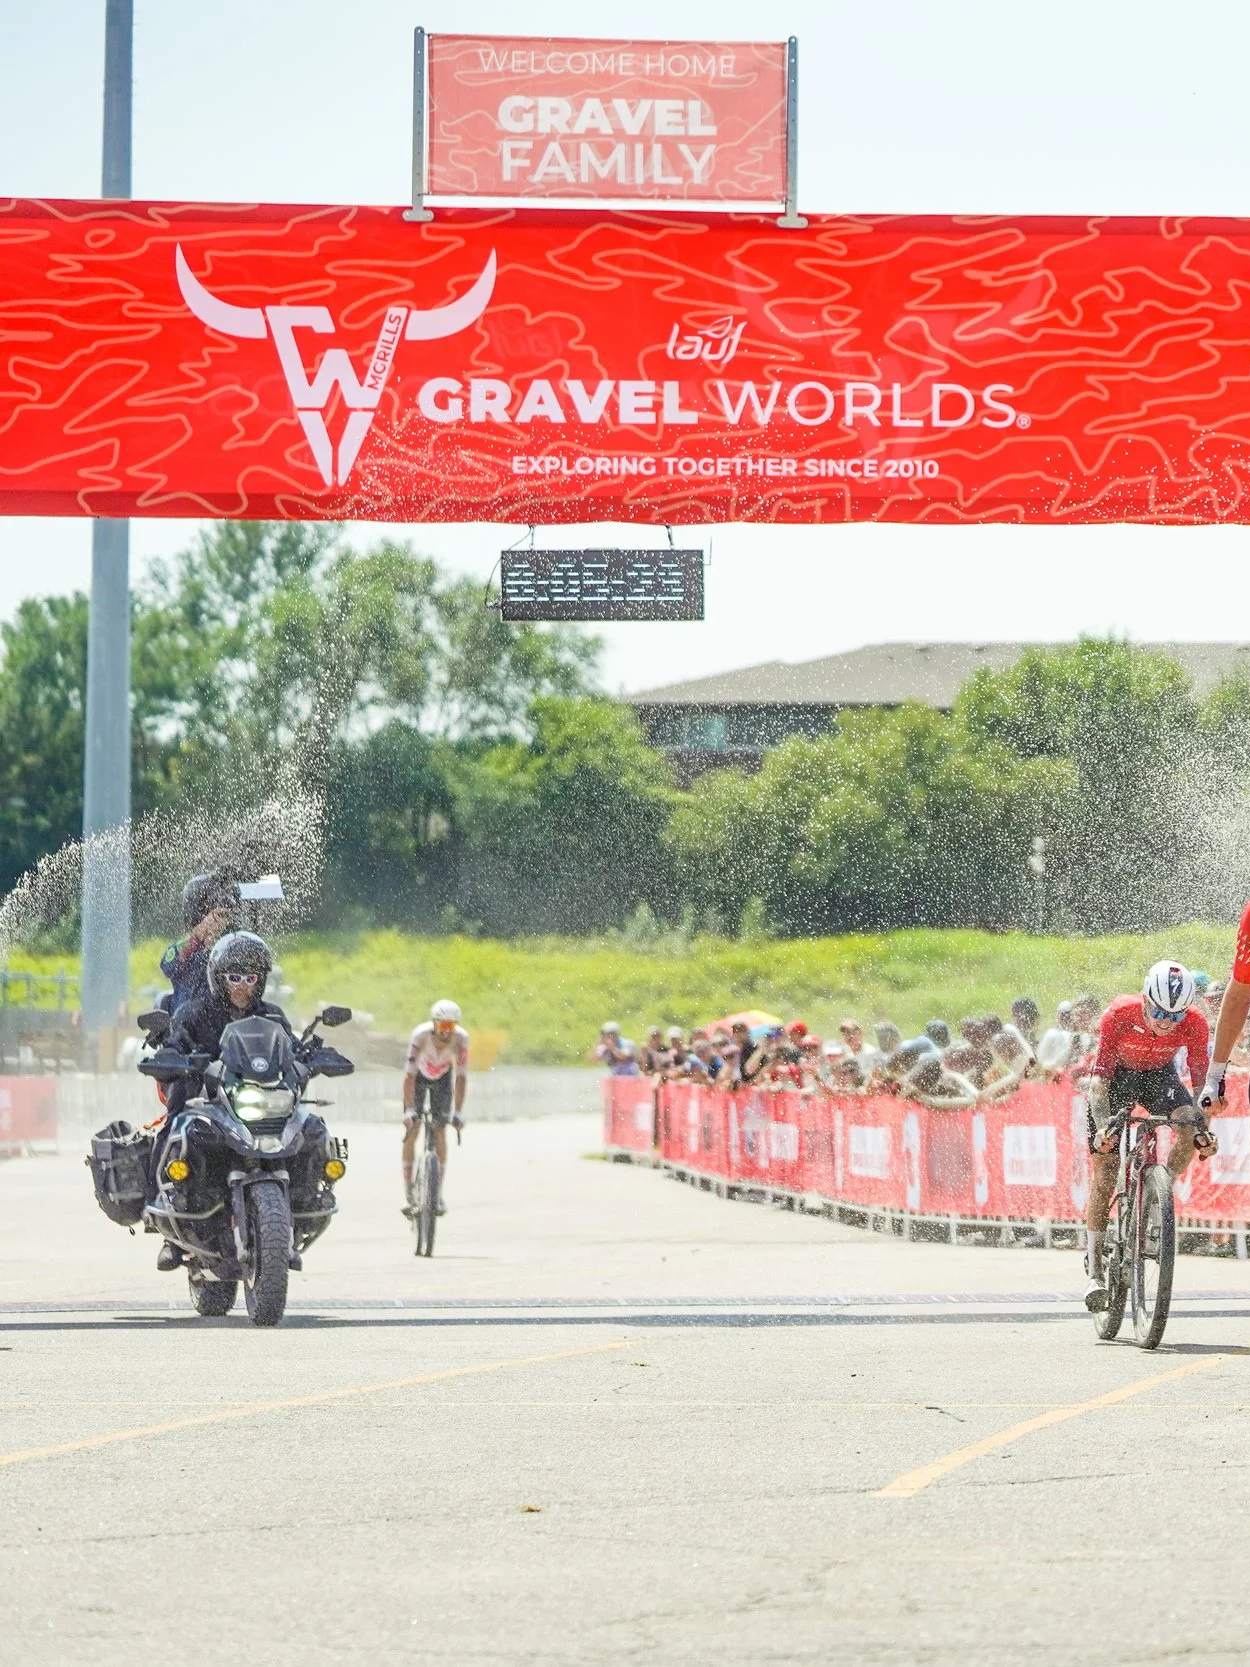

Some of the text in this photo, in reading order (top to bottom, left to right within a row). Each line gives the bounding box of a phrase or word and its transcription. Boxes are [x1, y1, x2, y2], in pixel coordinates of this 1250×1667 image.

[479, 49, 737, 78] WELCOME HOME
[498, 95, 717, 136] GRAVEL
[502, 141, 716, 185] FAMILY
[666, 316, 747, 364] lauf
[418, 377, 698, 425] GRAVEL
[512, 456, 939, 479] EXPLORING TOGETHER SINCE 2010
